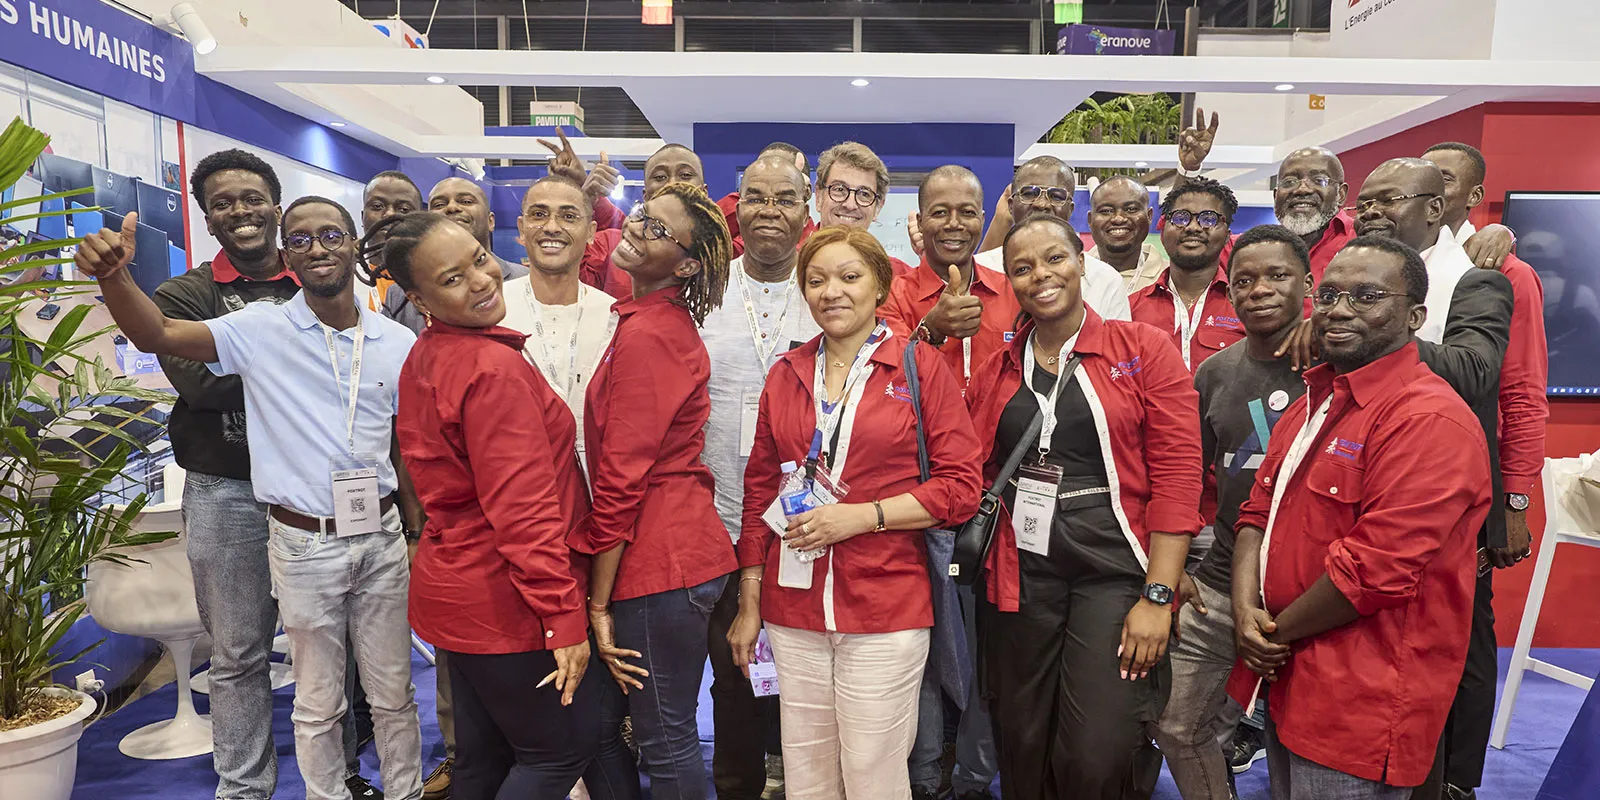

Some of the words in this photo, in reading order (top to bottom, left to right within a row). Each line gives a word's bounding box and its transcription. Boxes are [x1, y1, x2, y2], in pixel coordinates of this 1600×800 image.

[29, 2, 166, 83] HUMAINES
[1100, 36, 1151, 48] eranove
[535, 116, 570, 126] PAVILLON
